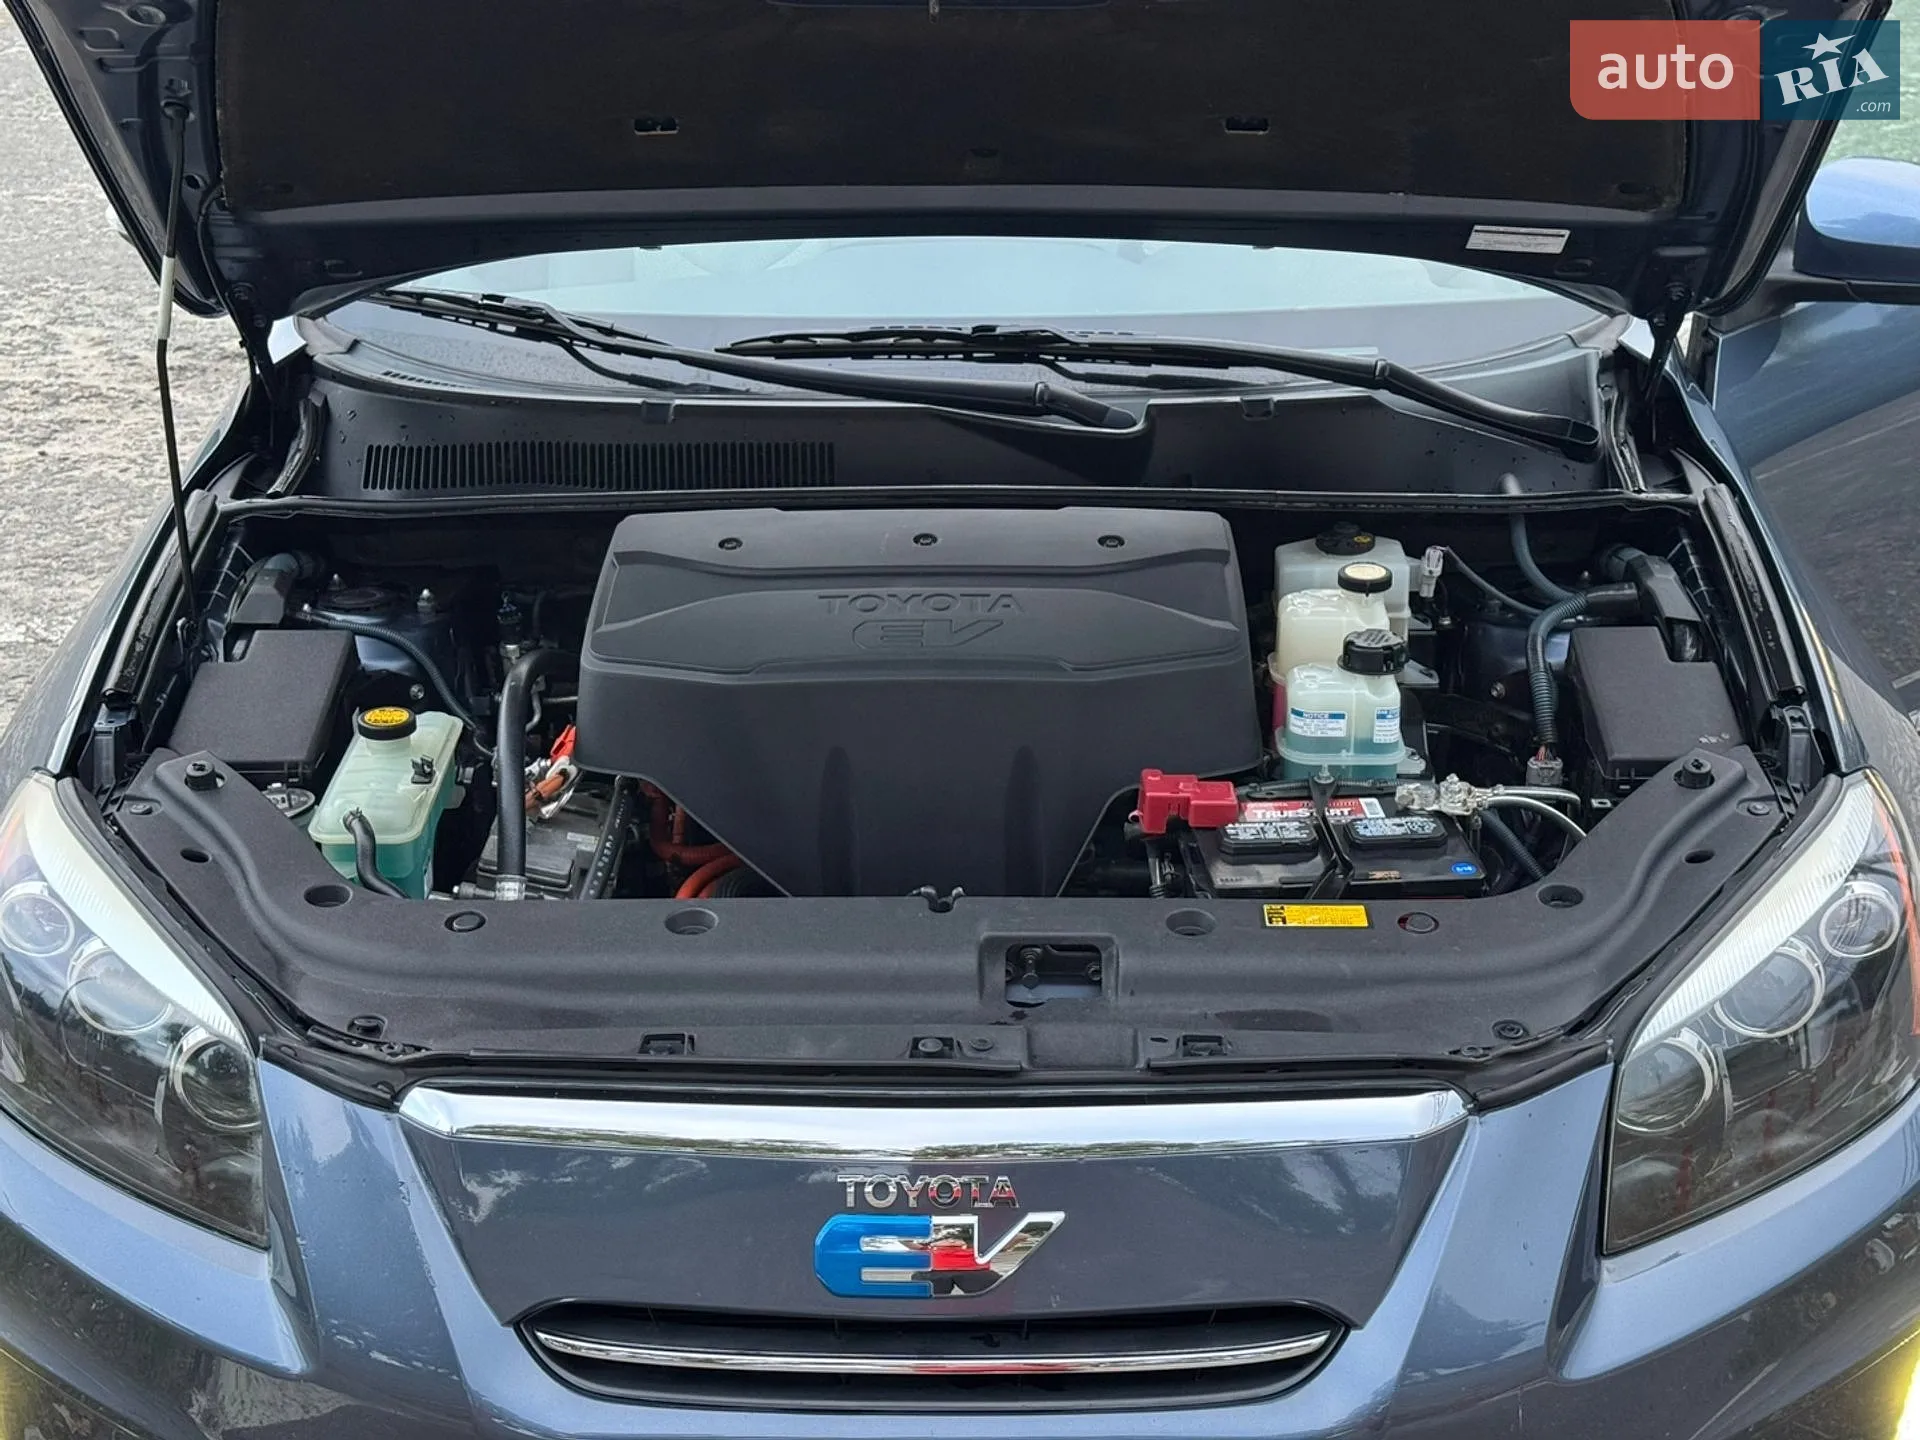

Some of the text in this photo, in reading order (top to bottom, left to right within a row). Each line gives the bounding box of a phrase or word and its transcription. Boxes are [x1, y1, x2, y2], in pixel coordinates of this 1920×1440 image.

[817, 593, 1024, 616] TOYOTA
[852, 619, 1004, 649] EV
[837, 1174, 1020, 1209] TOYOTA
[813, 1211, 1066, 1299] EV
